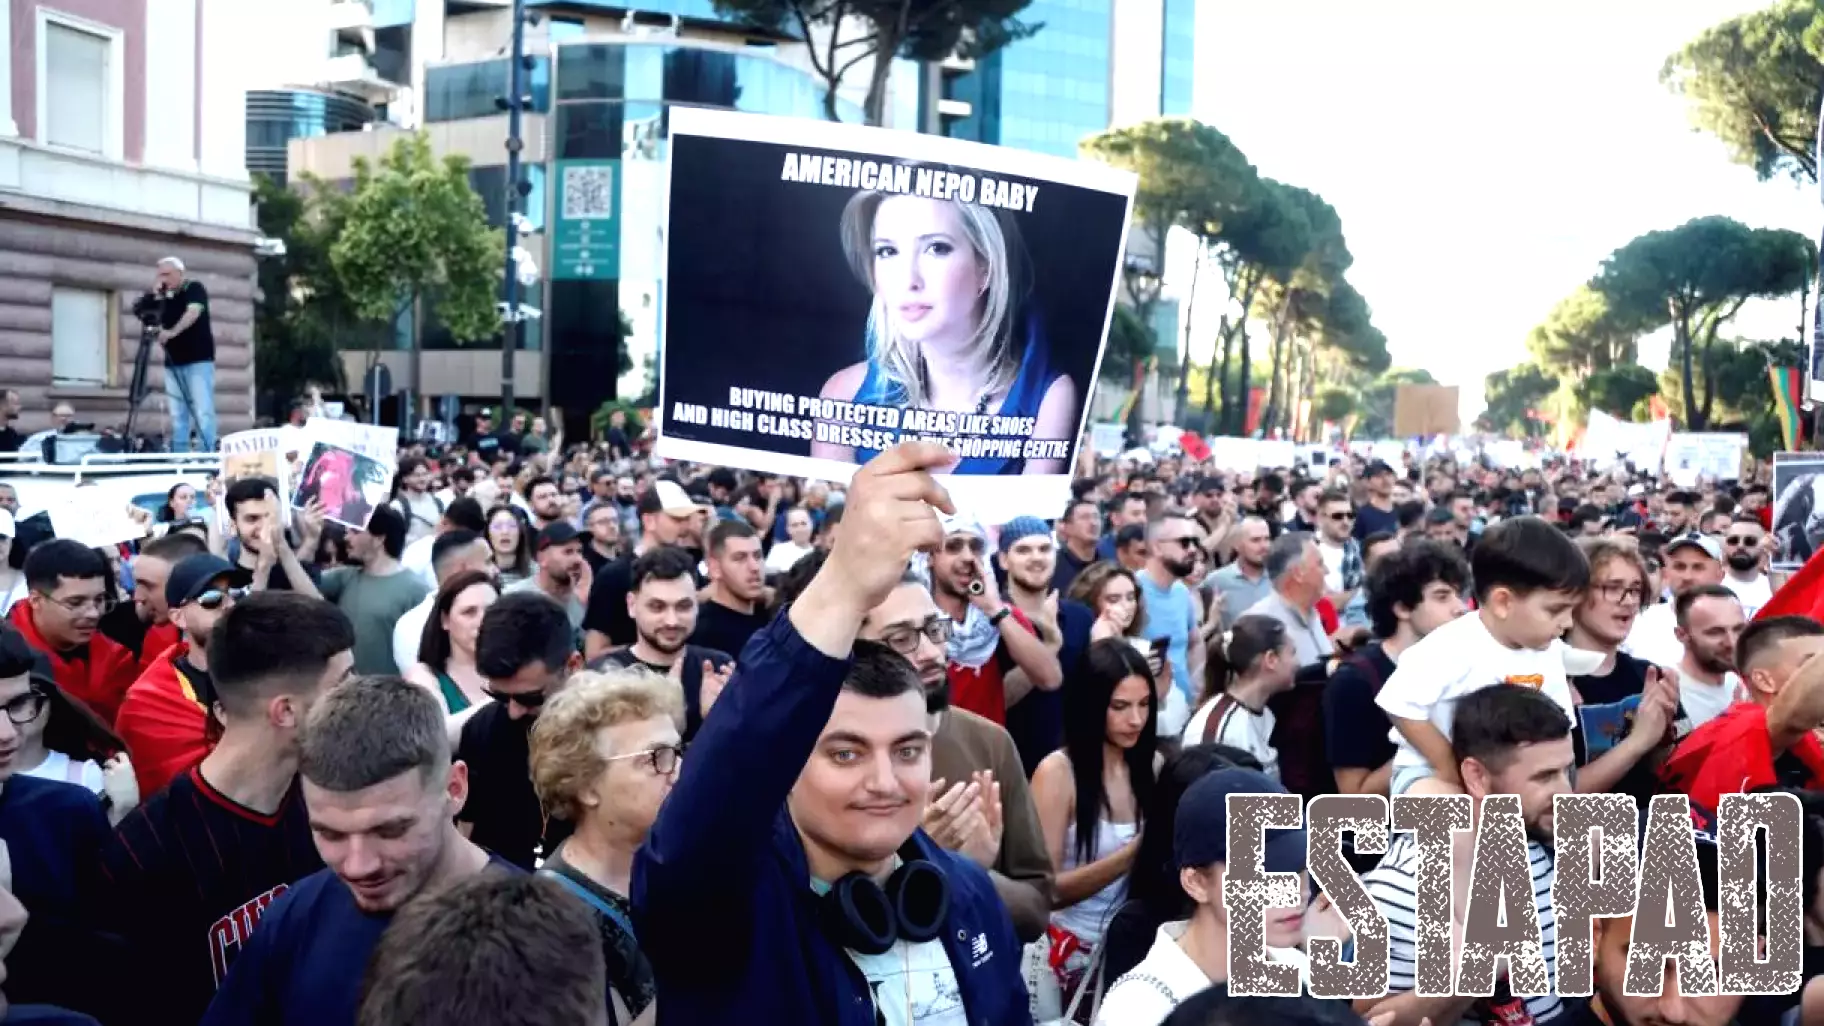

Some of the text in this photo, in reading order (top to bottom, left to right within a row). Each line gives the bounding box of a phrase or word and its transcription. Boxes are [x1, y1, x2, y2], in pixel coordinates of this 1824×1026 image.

[781, 153, 1039, 213] AMERICAN NEPO BABY
[672, 402, 708, 425] AND
[711, 407, 754, 432] HIGH
[757, 413, 813, 440] CLASS
[815, 422, 895, 450] DRESSES
[953, 437, 1023, 459] SHOPPING
[1022, 440, 1070, 459] CENTRE
[729, 386, 1036, 436] BUYING PROTECTED AREAS LIKE SHOES
[223, 436, 279, 454] WANTED
